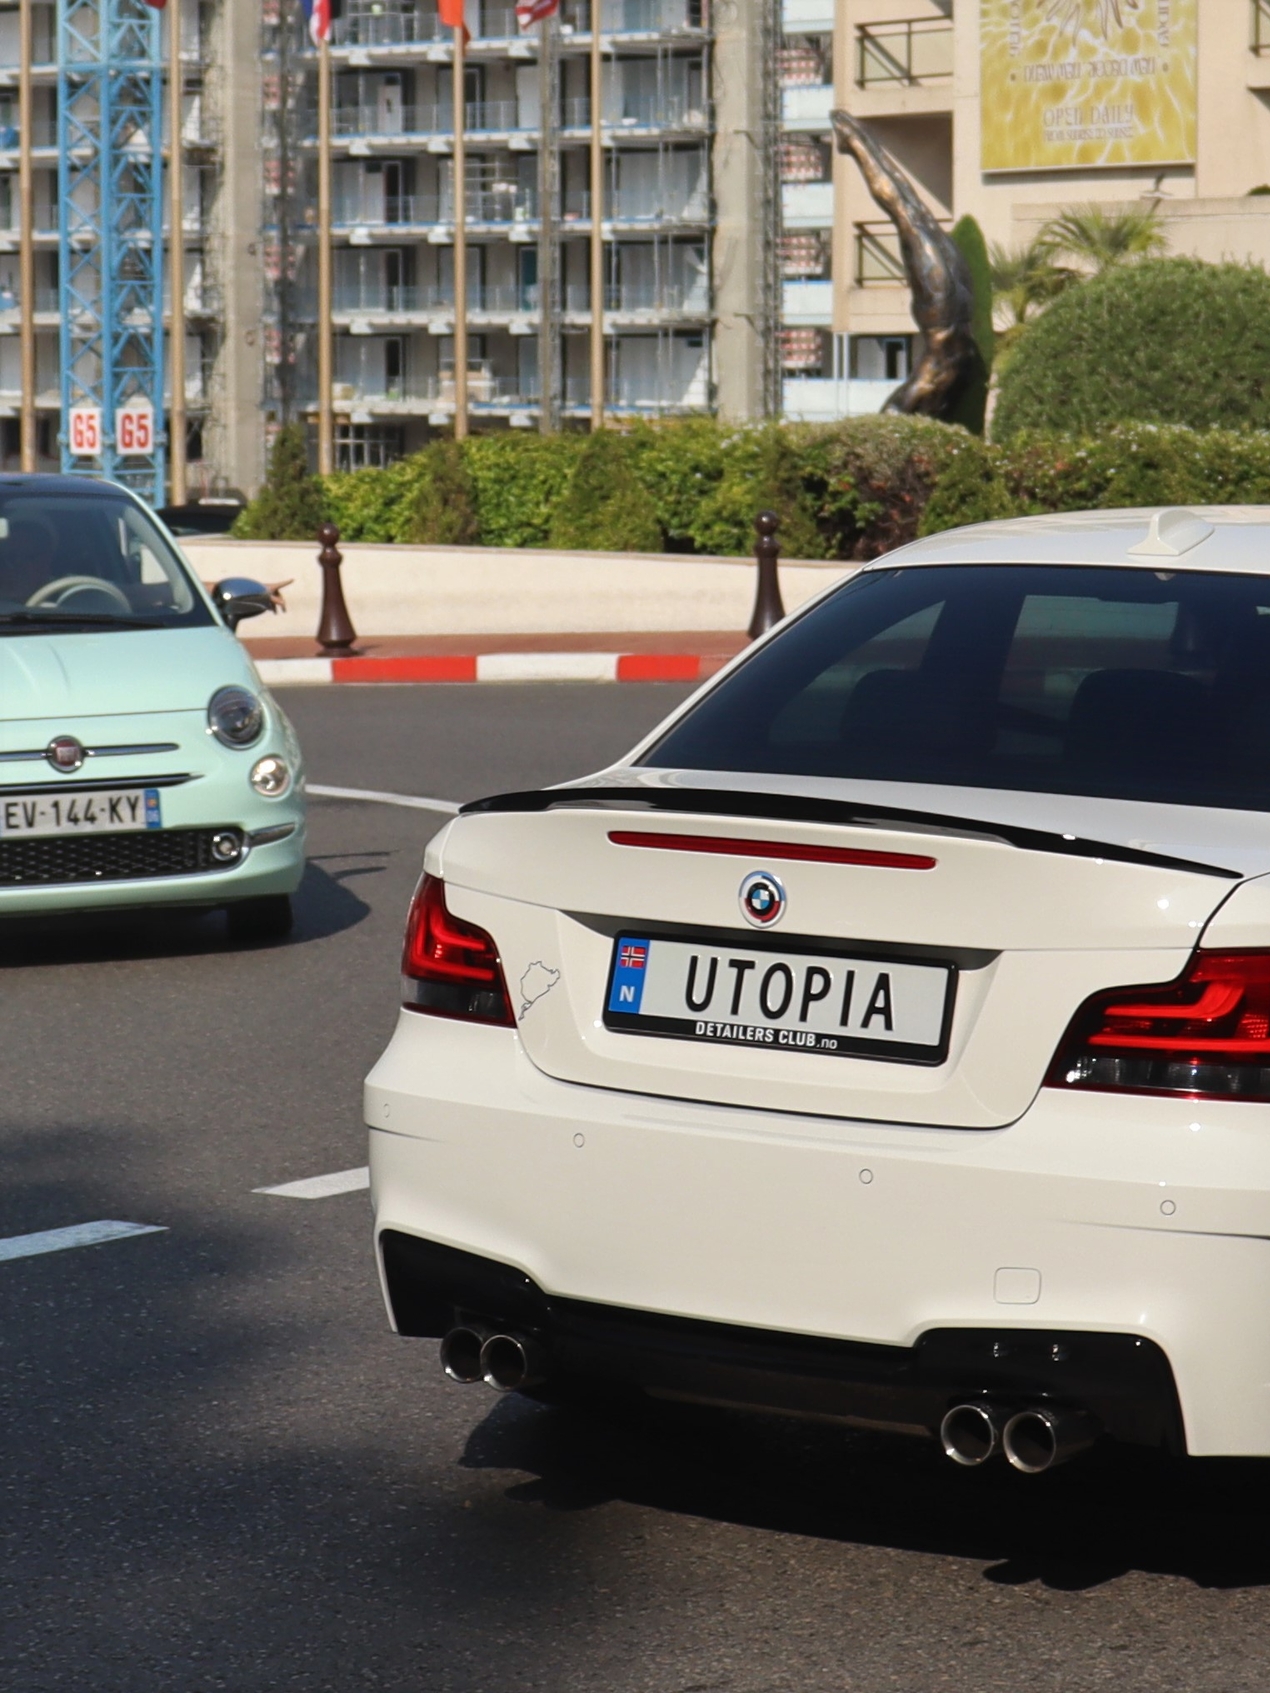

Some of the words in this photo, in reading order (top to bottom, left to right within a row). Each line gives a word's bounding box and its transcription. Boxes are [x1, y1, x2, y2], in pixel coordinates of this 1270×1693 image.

[4, 796, 140, 829] EV-144-KY
[619, 985, 636, 1003] N
[684, 954, 894, 1031] UTOPIA
[695, 1021, 775, 1043] DETAILERS
